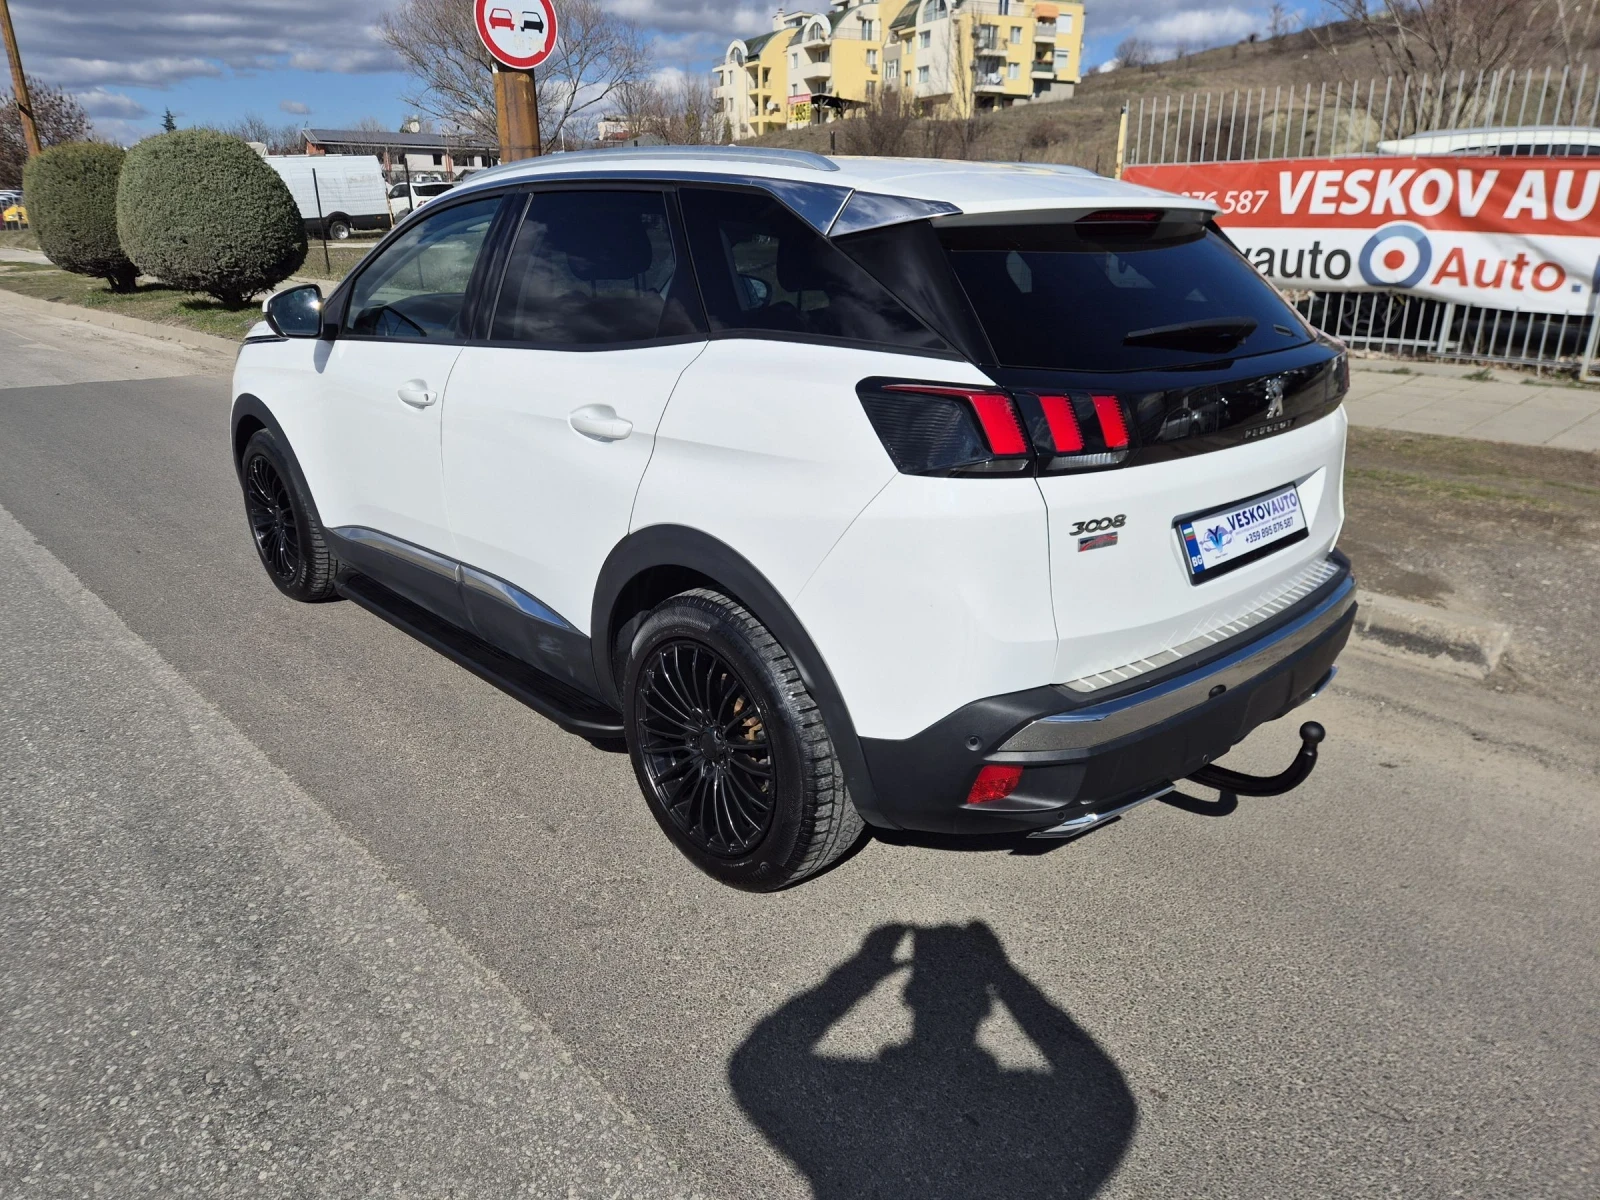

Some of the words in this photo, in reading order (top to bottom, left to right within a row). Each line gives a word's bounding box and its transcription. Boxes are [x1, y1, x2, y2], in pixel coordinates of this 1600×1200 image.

[1222, 190, 1270, 214] 587
[1279, 168, 1499, 218] VESKOV
[1502, 169, 1600, 222] AU
[1069, 513, 1127, 536] 3008
[1226, 492, 1297, 531] VESKOVAUTO
[1191, 554, 1203, 567] BG
